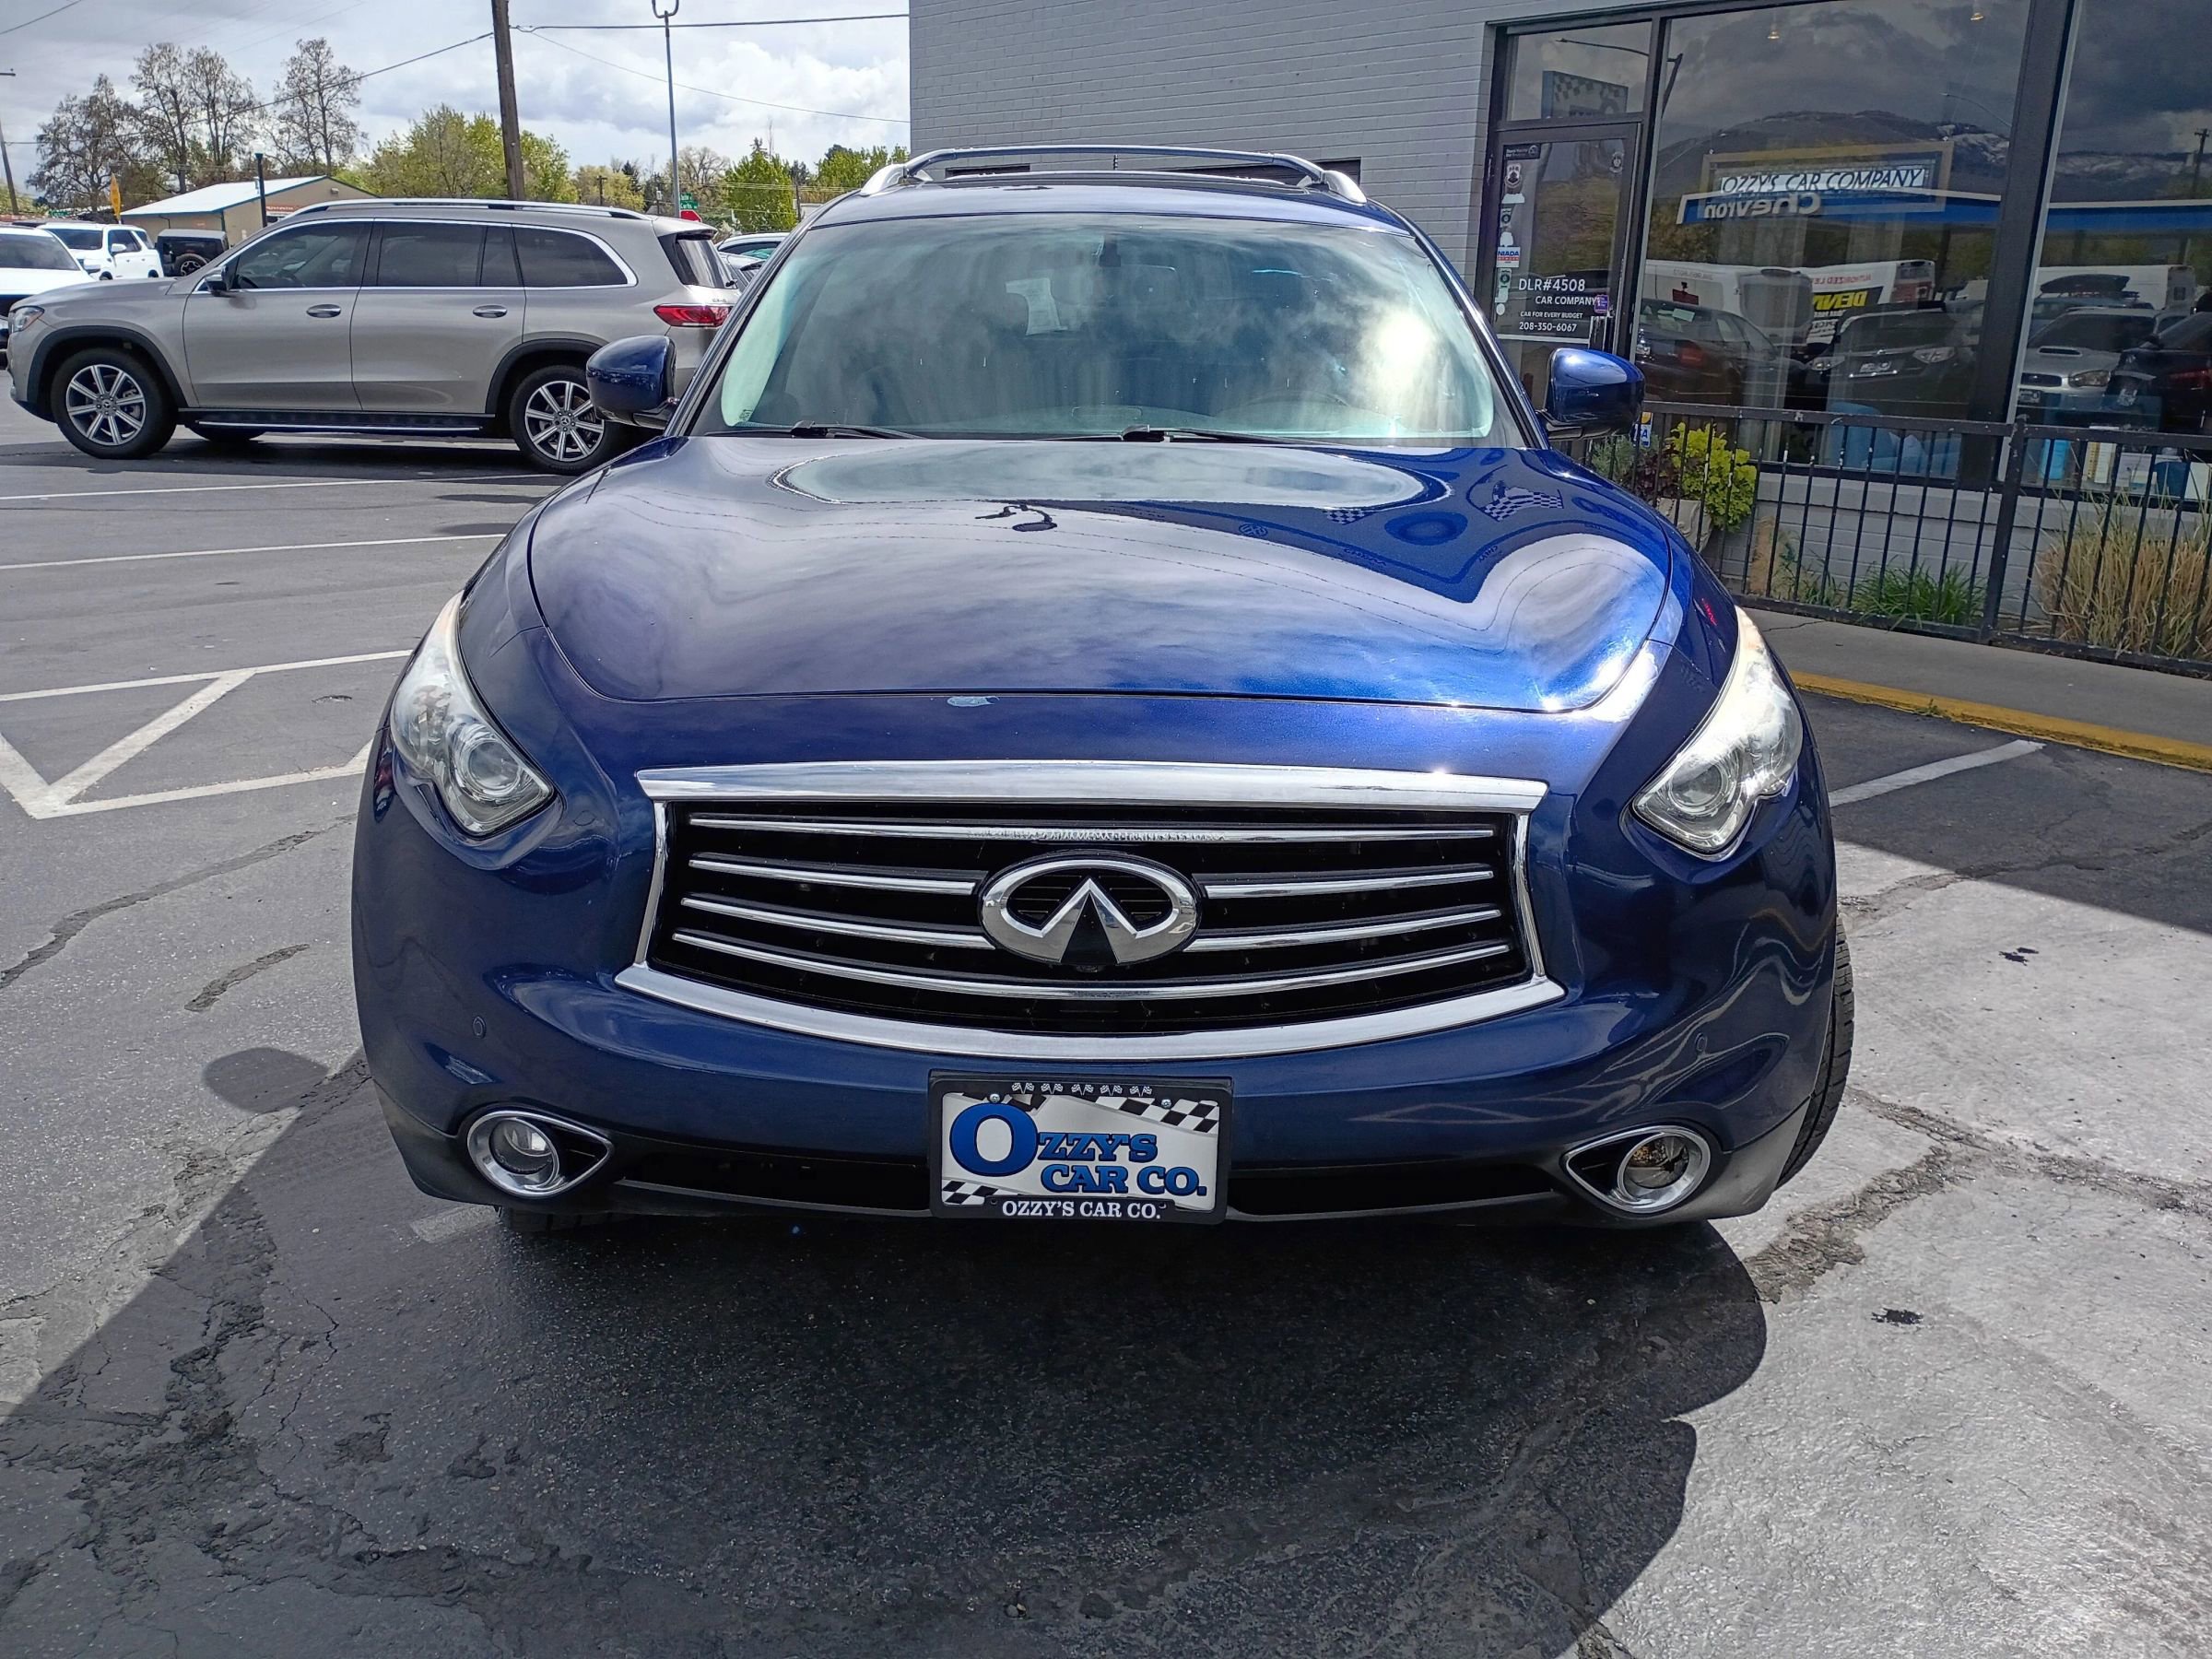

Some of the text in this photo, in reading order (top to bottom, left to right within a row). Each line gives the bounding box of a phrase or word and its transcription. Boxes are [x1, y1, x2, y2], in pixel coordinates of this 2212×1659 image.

[1723, 169, 1924, 194] OZZY'S CAR COMPANY
[1518, 278, 1586, 291] DLR#4508
[1535, 295, 1553, 305] CAR
[1555, 296, 1595, 306] COMPANY
[1519, 322, 1577, 332] 208-350-6067
[949, 1101, 1159, 1178] OZZY'S
[1041, 1164, 1207, 1196] CAR CO.
[1002, 1200, 1160, 1219] OZZY'S CAR CO.
